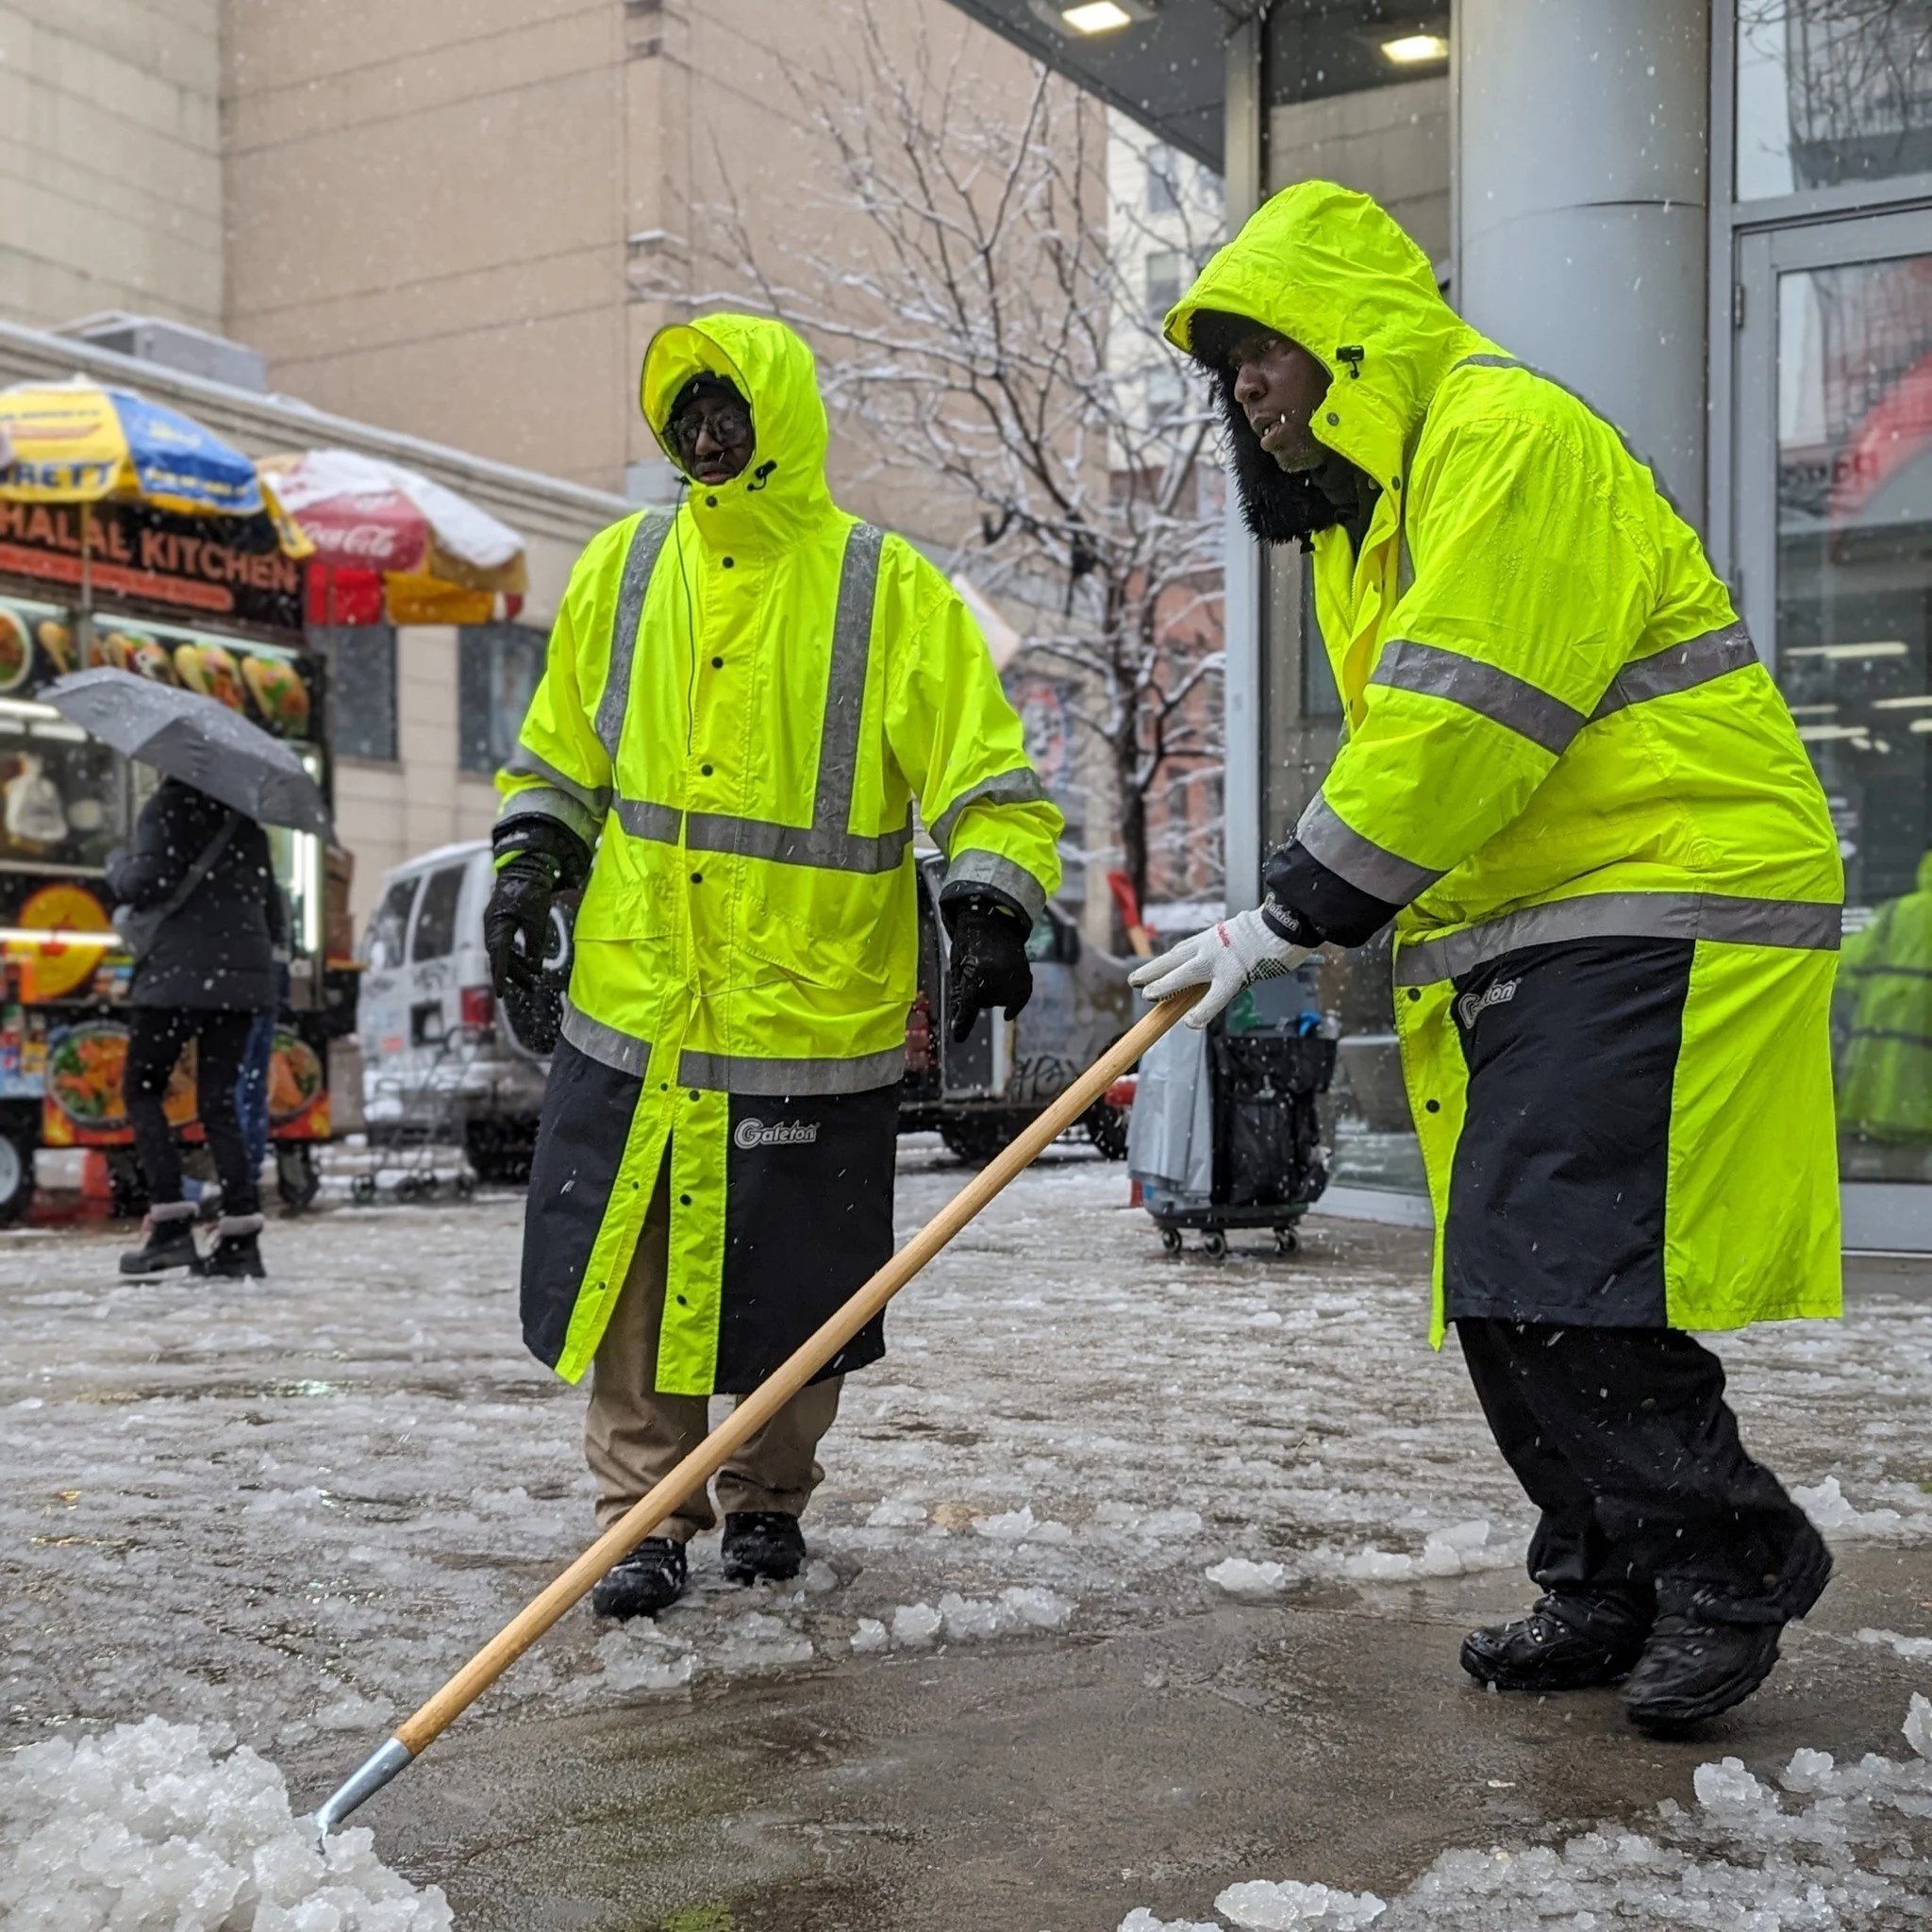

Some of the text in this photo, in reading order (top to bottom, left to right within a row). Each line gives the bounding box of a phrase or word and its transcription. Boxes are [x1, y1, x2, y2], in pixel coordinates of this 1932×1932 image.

[0, 500, 131, 562] HALAL
[141, 527, 297, 593] KITCHEN
[734, 1117, 817, 1149] Galeton
